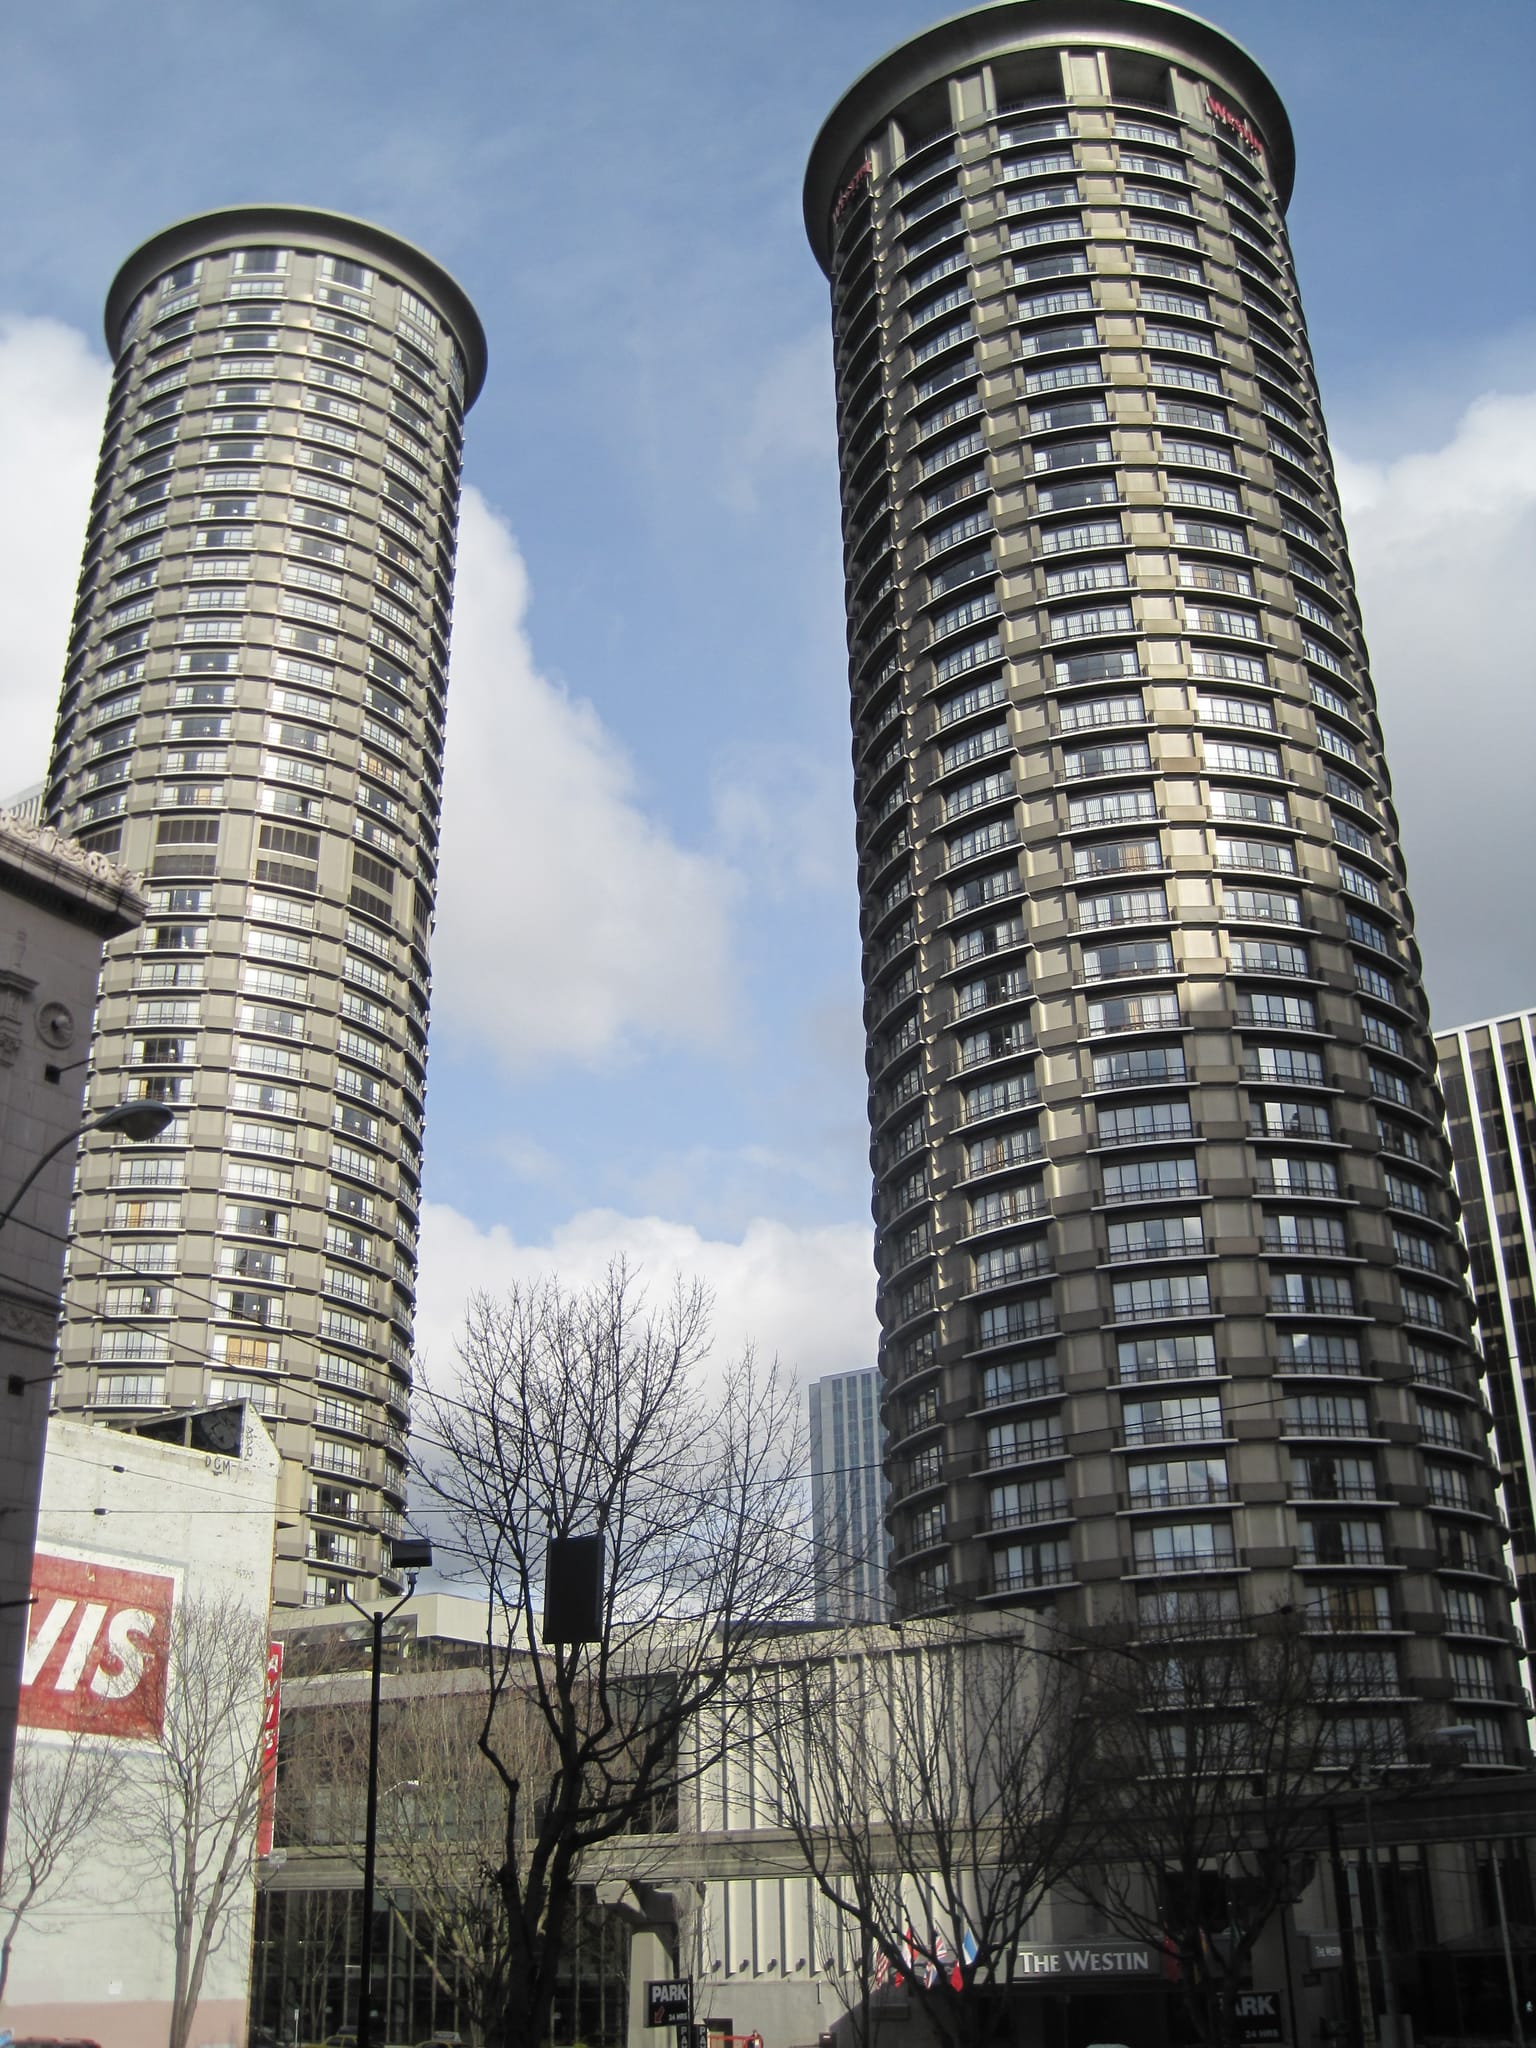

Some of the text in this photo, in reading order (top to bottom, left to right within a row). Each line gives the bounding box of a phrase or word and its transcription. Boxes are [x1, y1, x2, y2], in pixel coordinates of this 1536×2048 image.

[1019, 1950, 1149, 1973] THE WESTIN
[652, 1984, 688, 2003] PARK
[1234, 1995, 1276, 2016] RK
